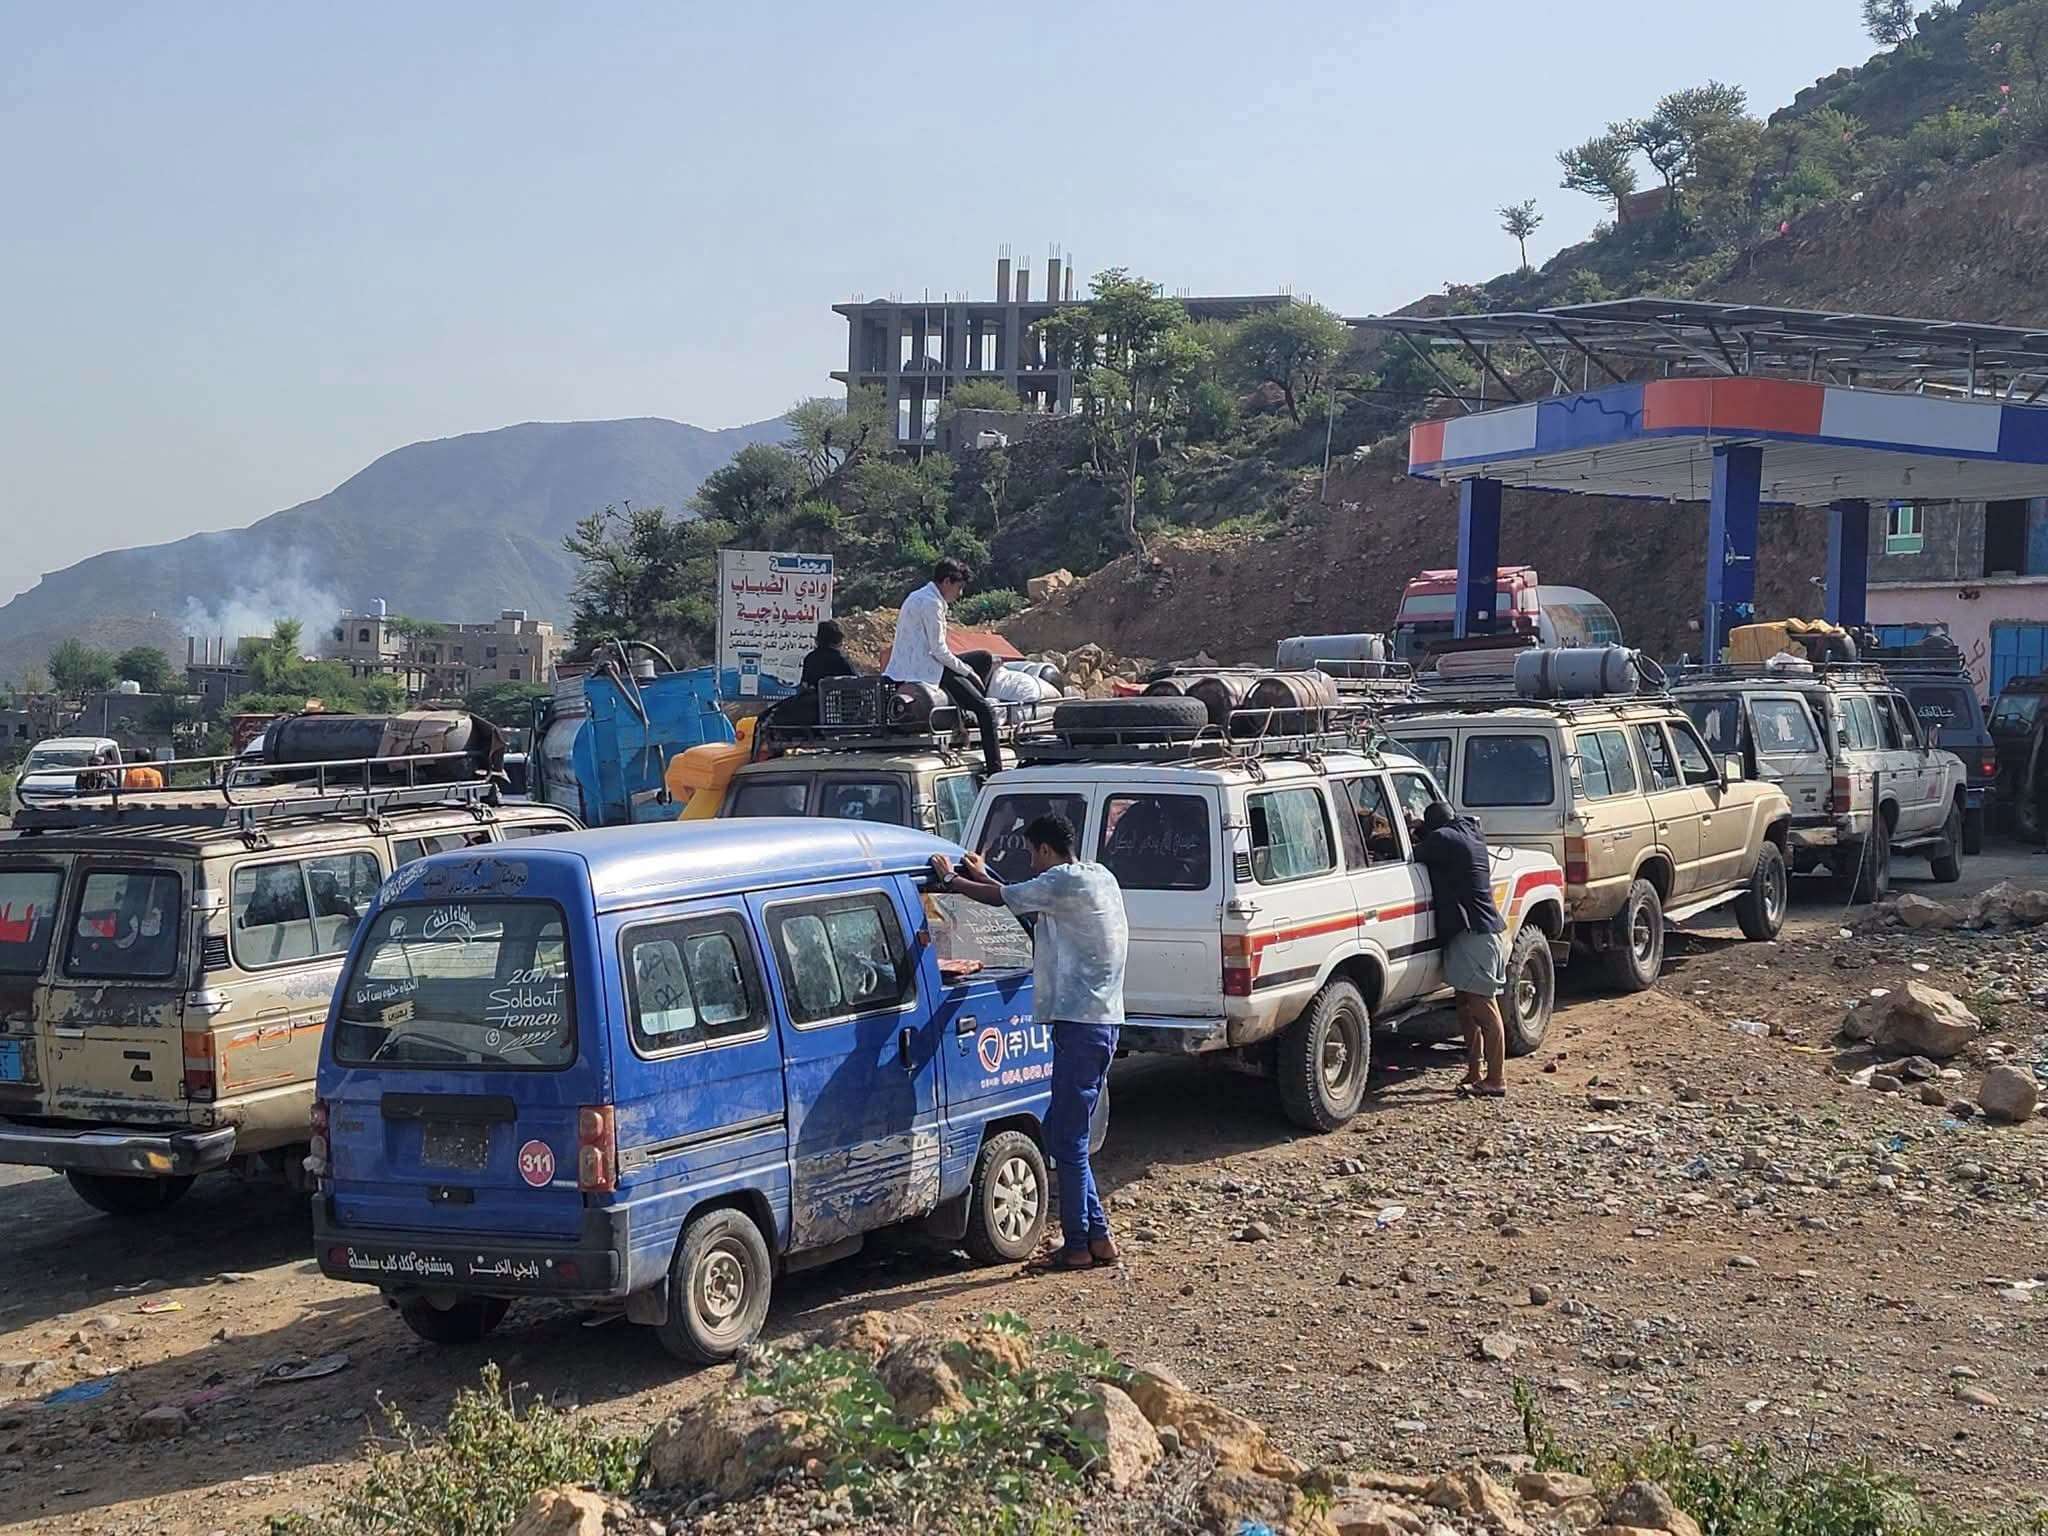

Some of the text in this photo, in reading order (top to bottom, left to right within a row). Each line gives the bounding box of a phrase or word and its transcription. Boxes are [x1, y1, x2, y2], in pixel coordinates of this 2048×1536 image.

[768, 555, 828, 574] محطة
[731, 575, 827, 602] وادي الضباب
[736, 602, 820, 627] النموذجية
[486, 983, 565, 1010] Soldout
[522, 1154, 552, 1173] 311
